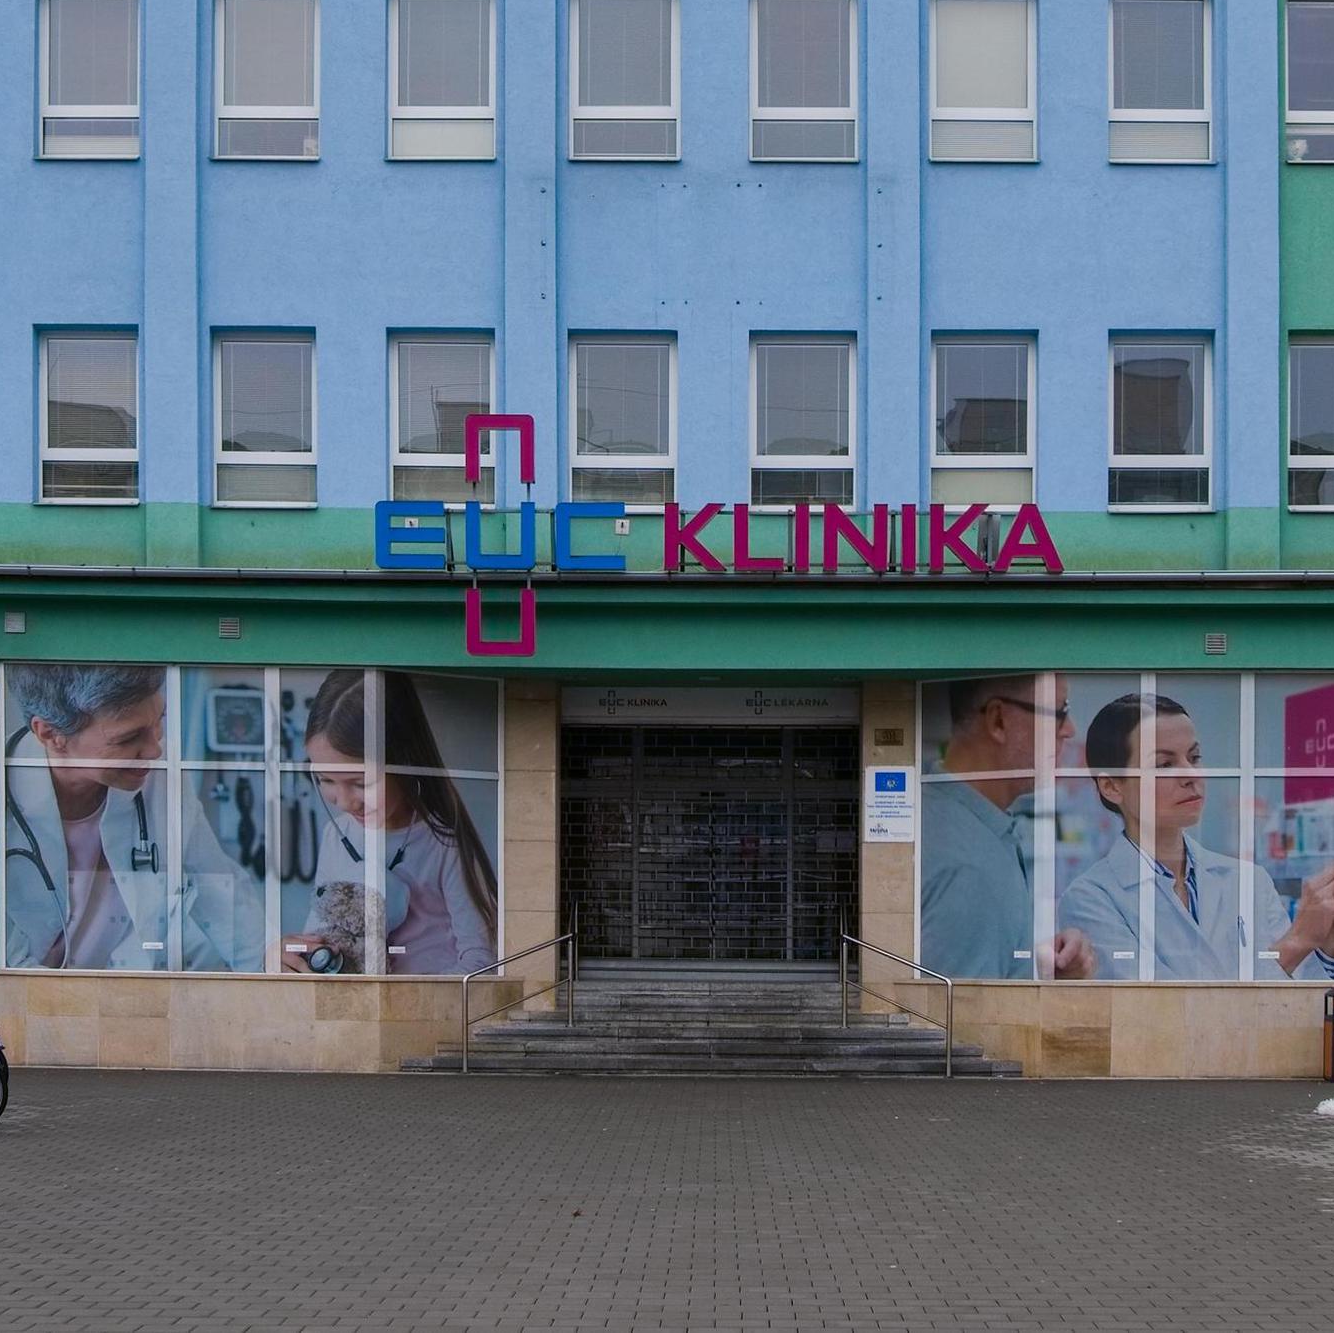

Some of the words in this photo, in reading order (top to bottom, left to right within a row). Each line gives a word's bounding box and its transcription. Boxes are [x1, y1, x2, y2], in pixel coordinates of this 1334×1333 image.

[374, 501, 626, 571] EUC
[664, 503, 1064, 573] KLINIKA
[627, 699, 668, 707] KLINIKA
